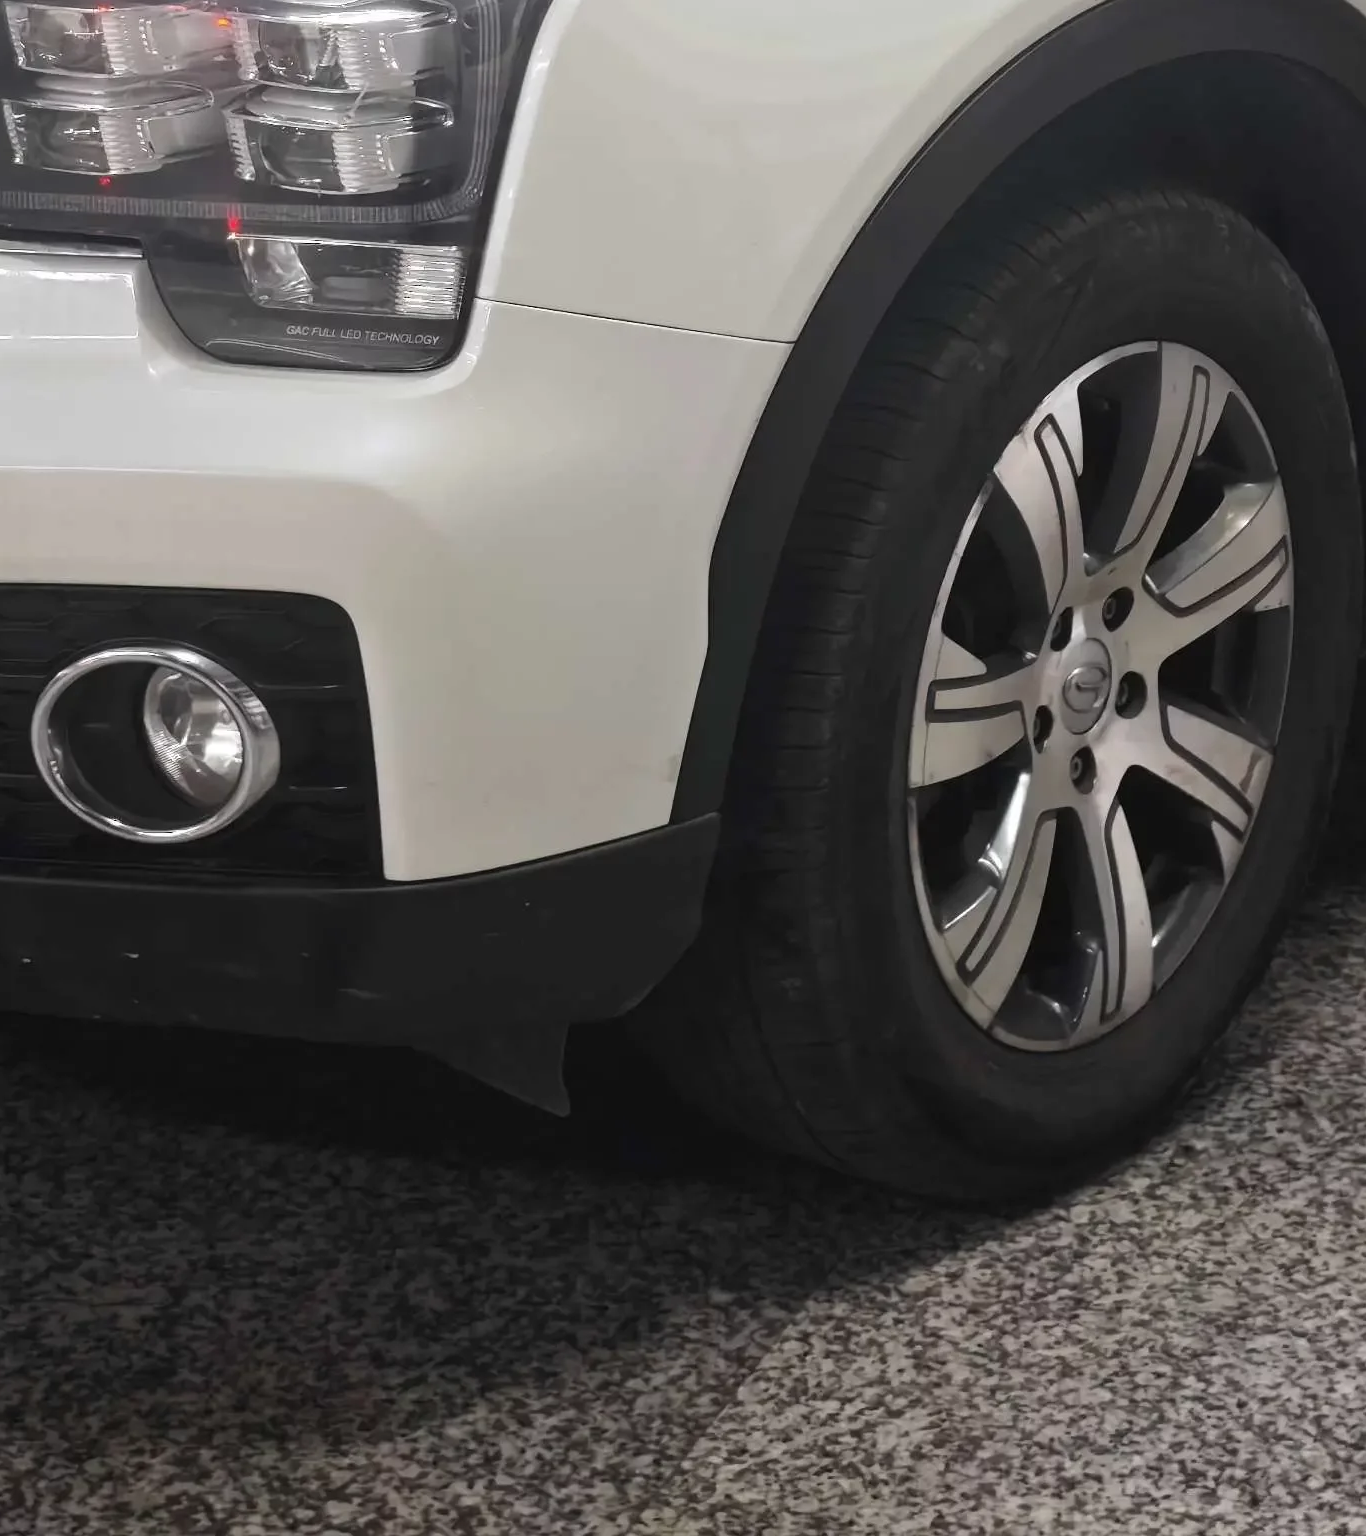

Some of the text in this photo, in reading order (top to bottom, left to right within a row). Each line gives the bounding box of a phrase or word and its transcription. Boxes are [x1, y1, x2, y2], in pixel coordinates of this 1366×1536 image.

[286, 325, 440, 346] GAC FULL LED TECHNOLOGY
